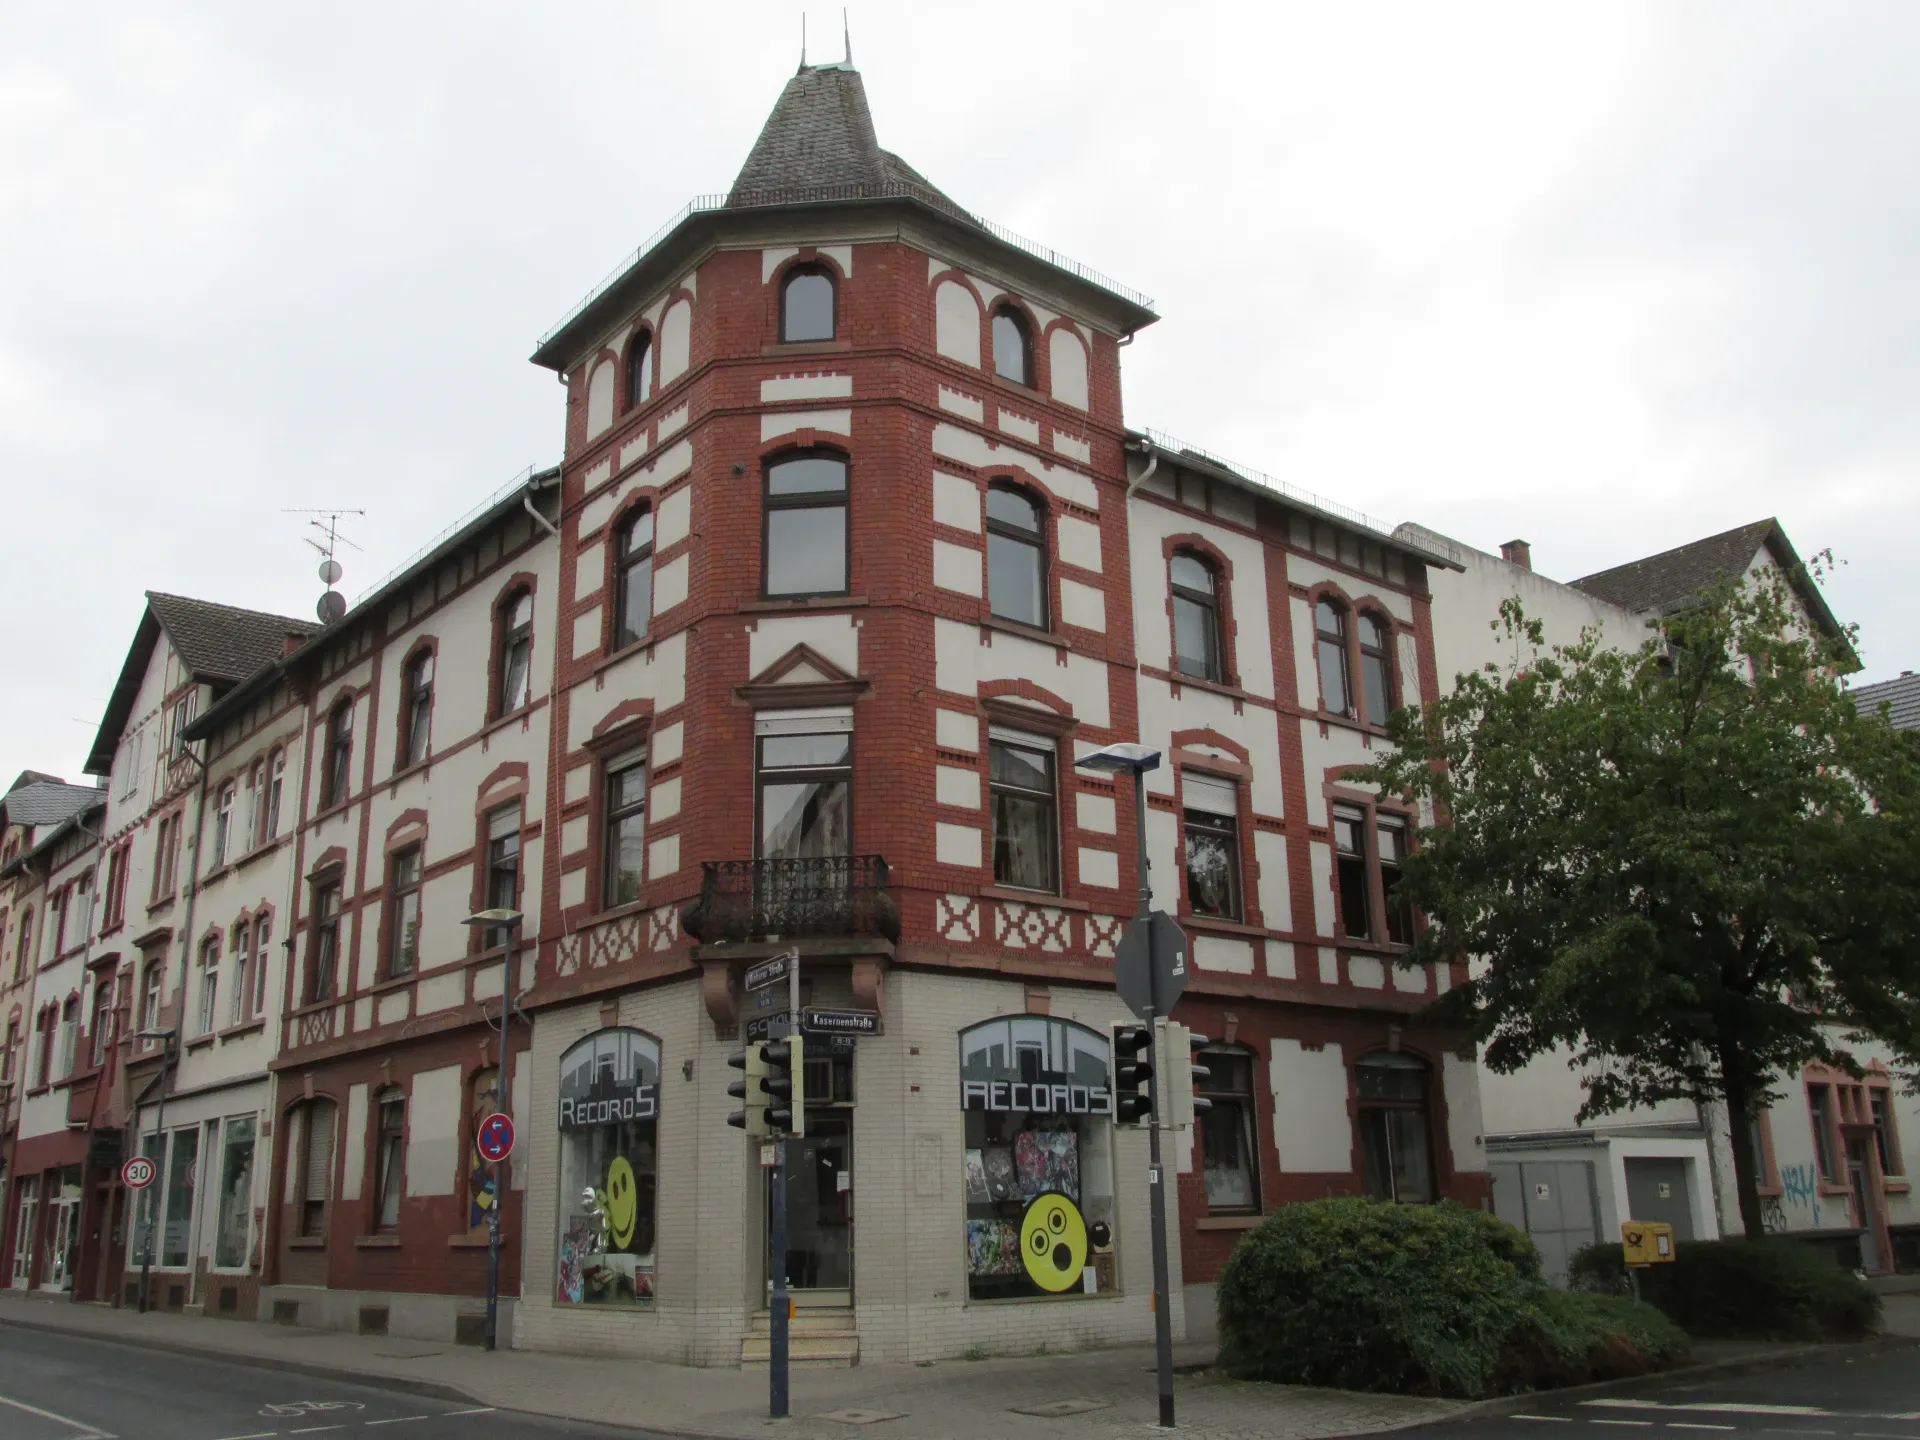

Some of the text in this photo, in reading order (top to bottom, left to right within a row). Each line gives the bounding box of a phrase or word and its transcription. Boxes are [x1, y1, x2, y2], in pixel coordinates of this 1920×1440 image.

[813, 1014, 873, 1029] Kasernenstraße
[559, 1084, 656, 1127] RECORDS
[963, 1080, 1113, 1114] RECORDS
[130, 1165, 149, 1180] 30
